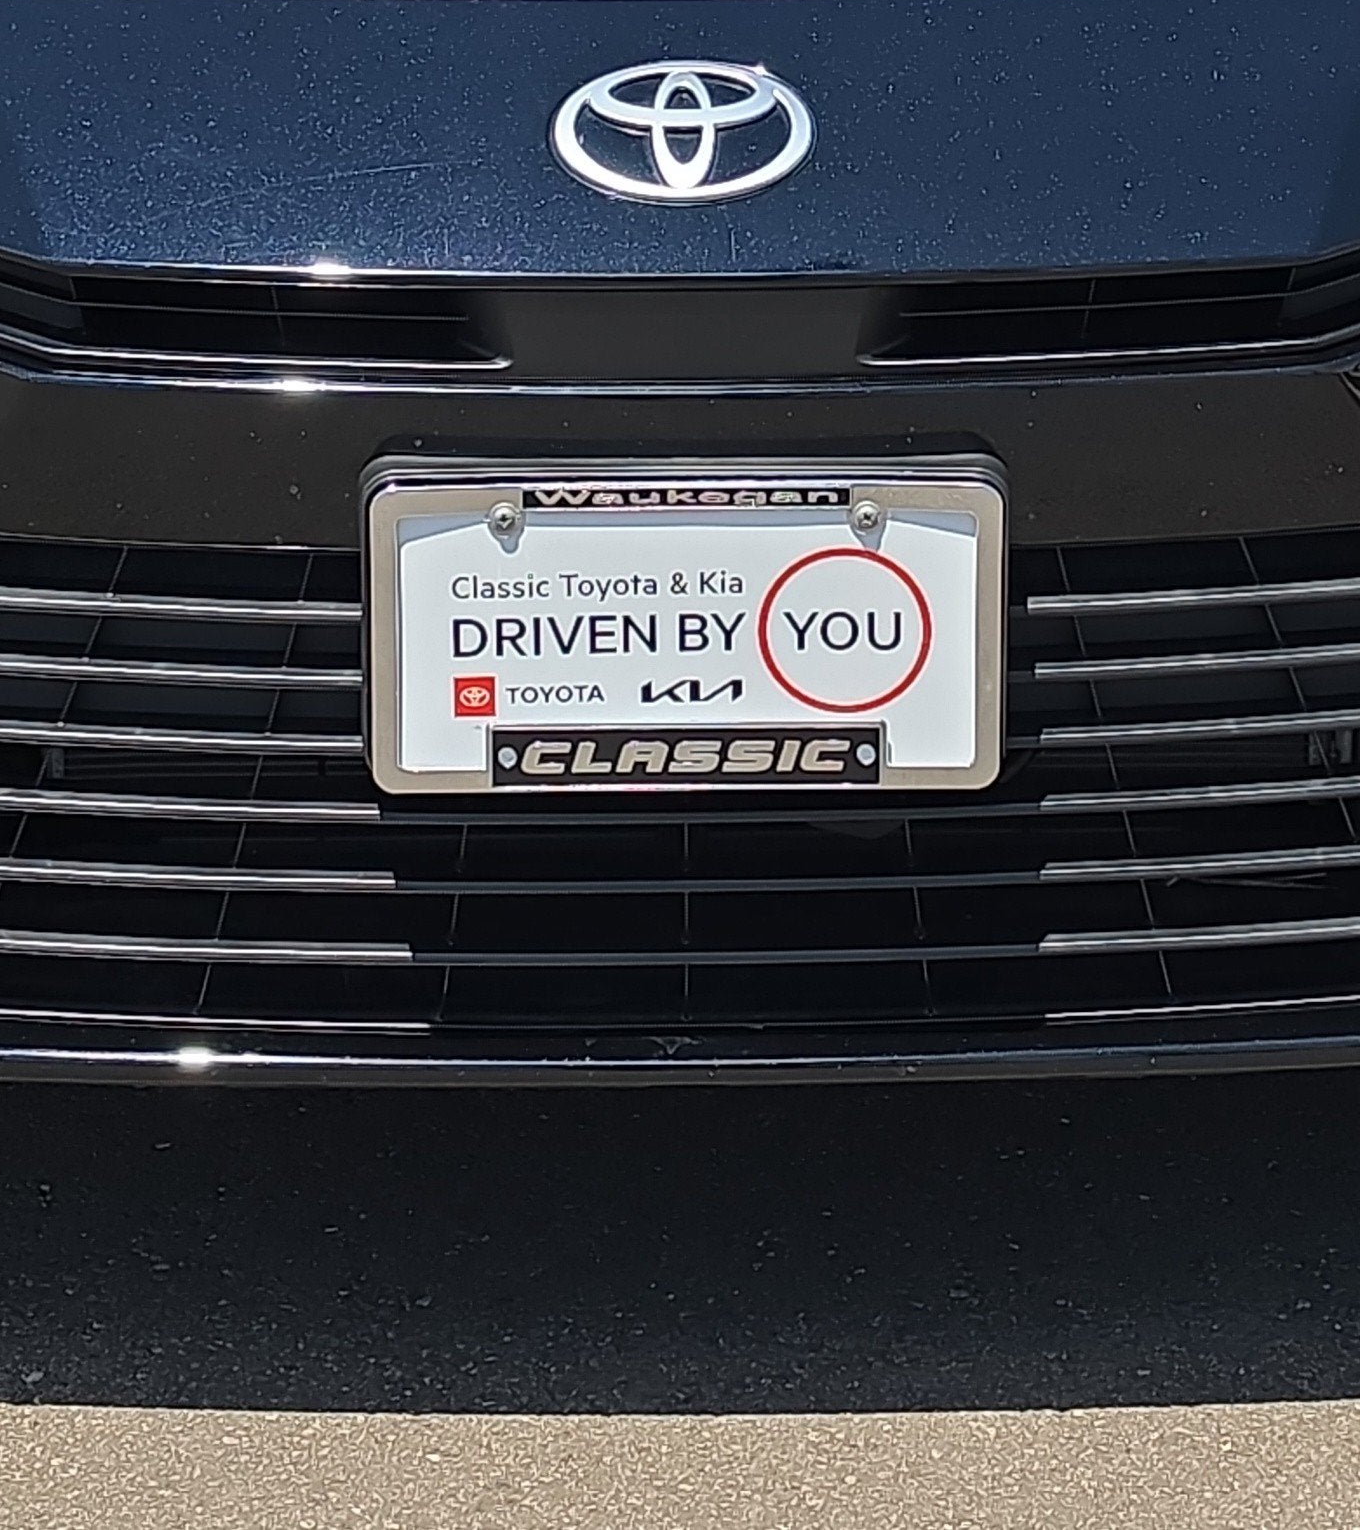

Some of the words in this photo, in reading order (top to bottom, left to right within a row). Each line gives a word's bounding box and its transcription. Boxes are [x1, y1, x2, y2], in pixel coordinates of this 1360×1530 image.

[535, 488, 840, 507] Waukegan
[451, 575, 550, 600] Classic
[558, 572, 658, 602] Toyota
[669, 571, 689, 595] &
[699, 570, 744, 594] Kia
[452, 613, 658, 658] DRIVEN
[678, 612, 747, 653] BY
[784, 612, 903, 652] YOU
[505, 685, 605, 704] TOYOTA
[520, 739, 850, 775] CLASSIC
